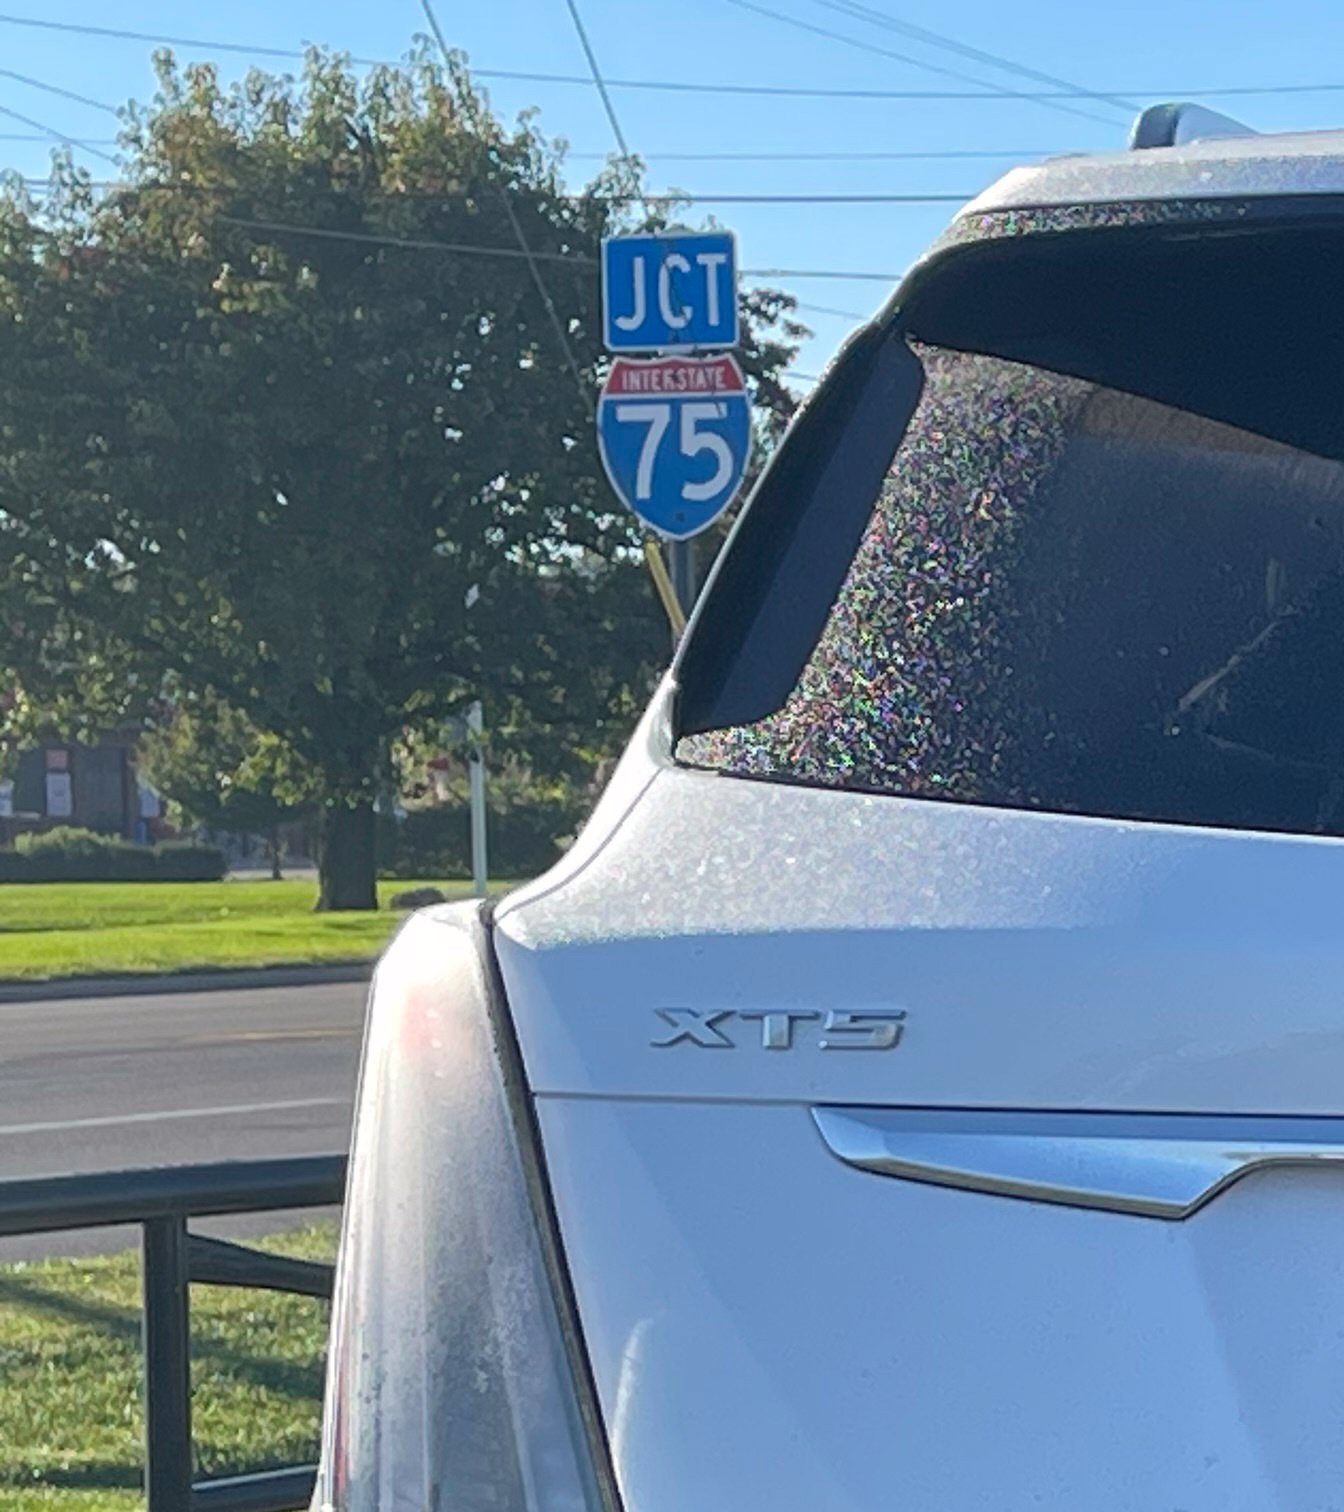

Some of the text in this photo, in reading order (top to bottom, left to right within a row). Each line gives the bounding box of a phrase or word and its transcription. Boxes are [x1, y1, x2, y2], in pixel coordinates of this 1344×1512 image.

[616, 253, 726, 331] JCT
[622, 366, 726, 392] INTERSTATE
[616, 404, 734, 500] 75
[650, 1008, 908, 1050] XT5
